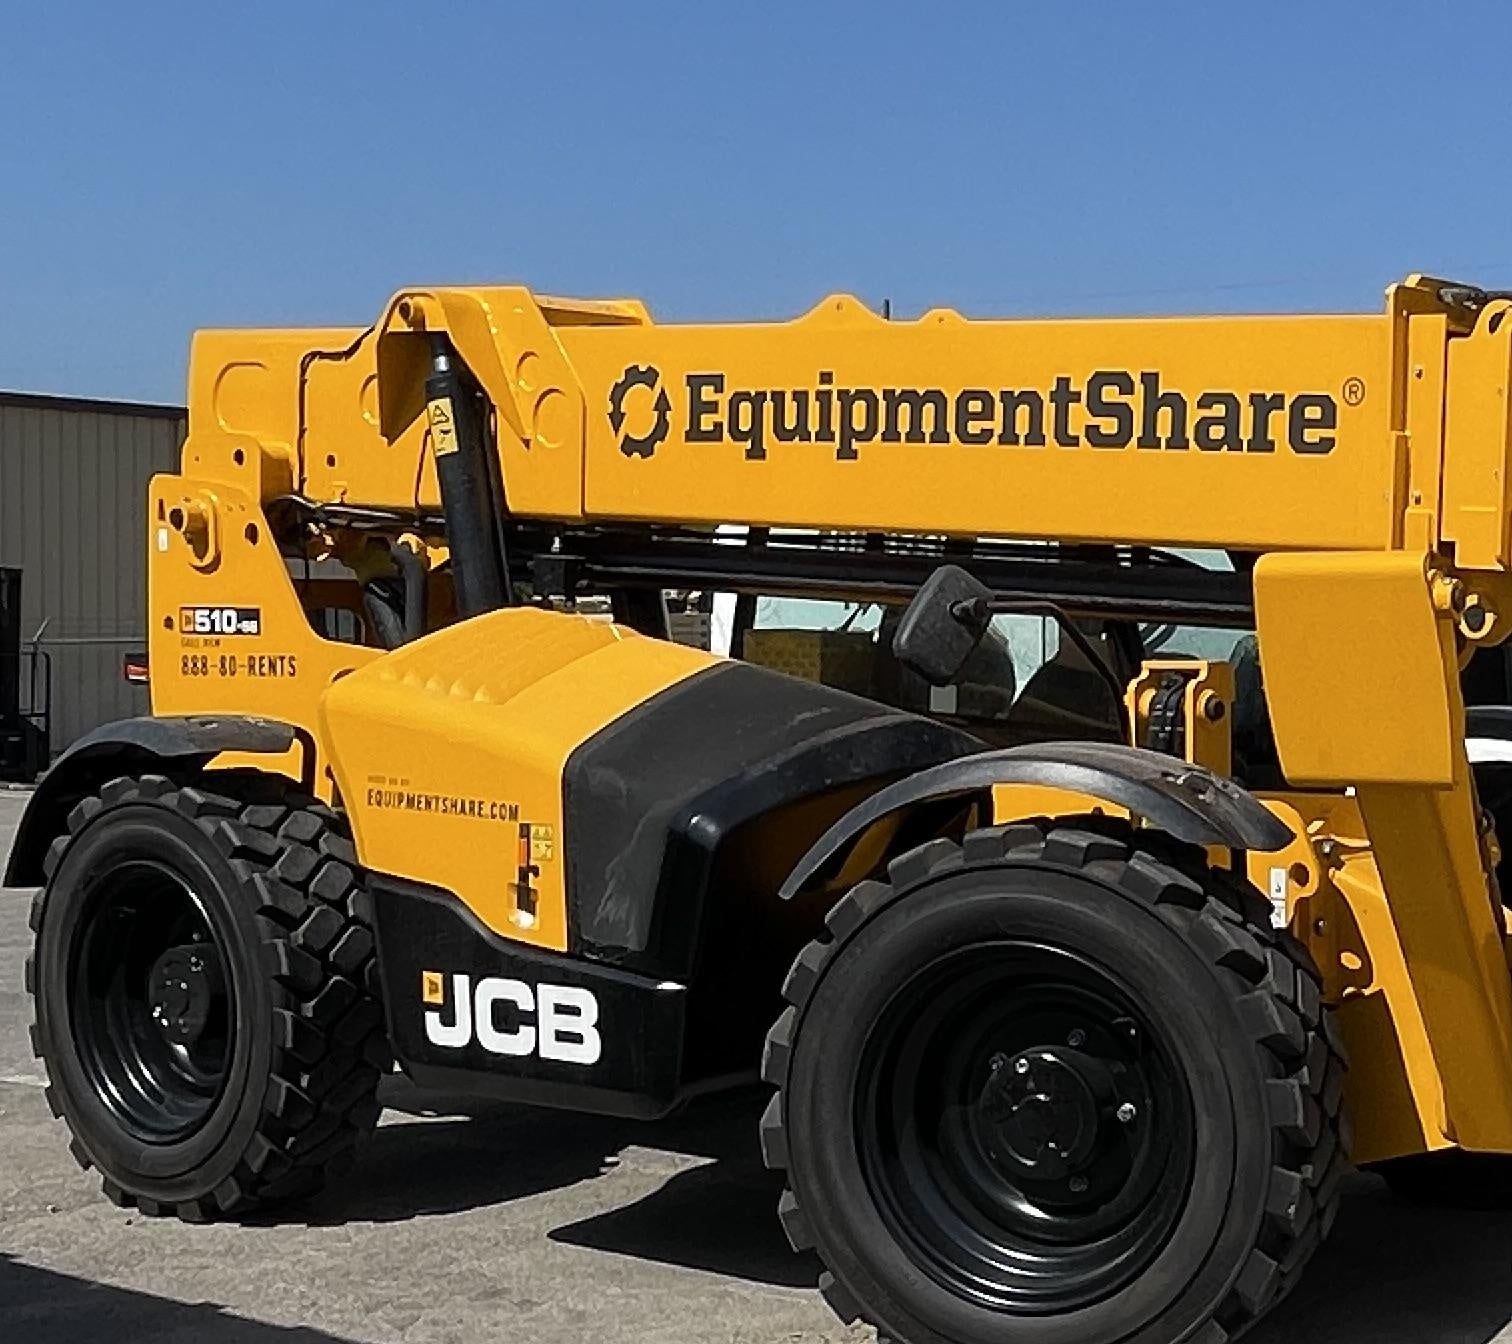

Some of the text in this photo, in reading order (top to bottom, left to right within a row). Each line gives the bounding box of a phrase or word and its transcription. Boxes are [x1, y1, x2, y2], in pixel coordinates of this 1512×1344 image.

[181, 655, 296, 677] 888-80-RENTS
[367, 787, 519, 822] EQUIPMENTSHARE.COM
[424, 974, 601, 1064] JCB
